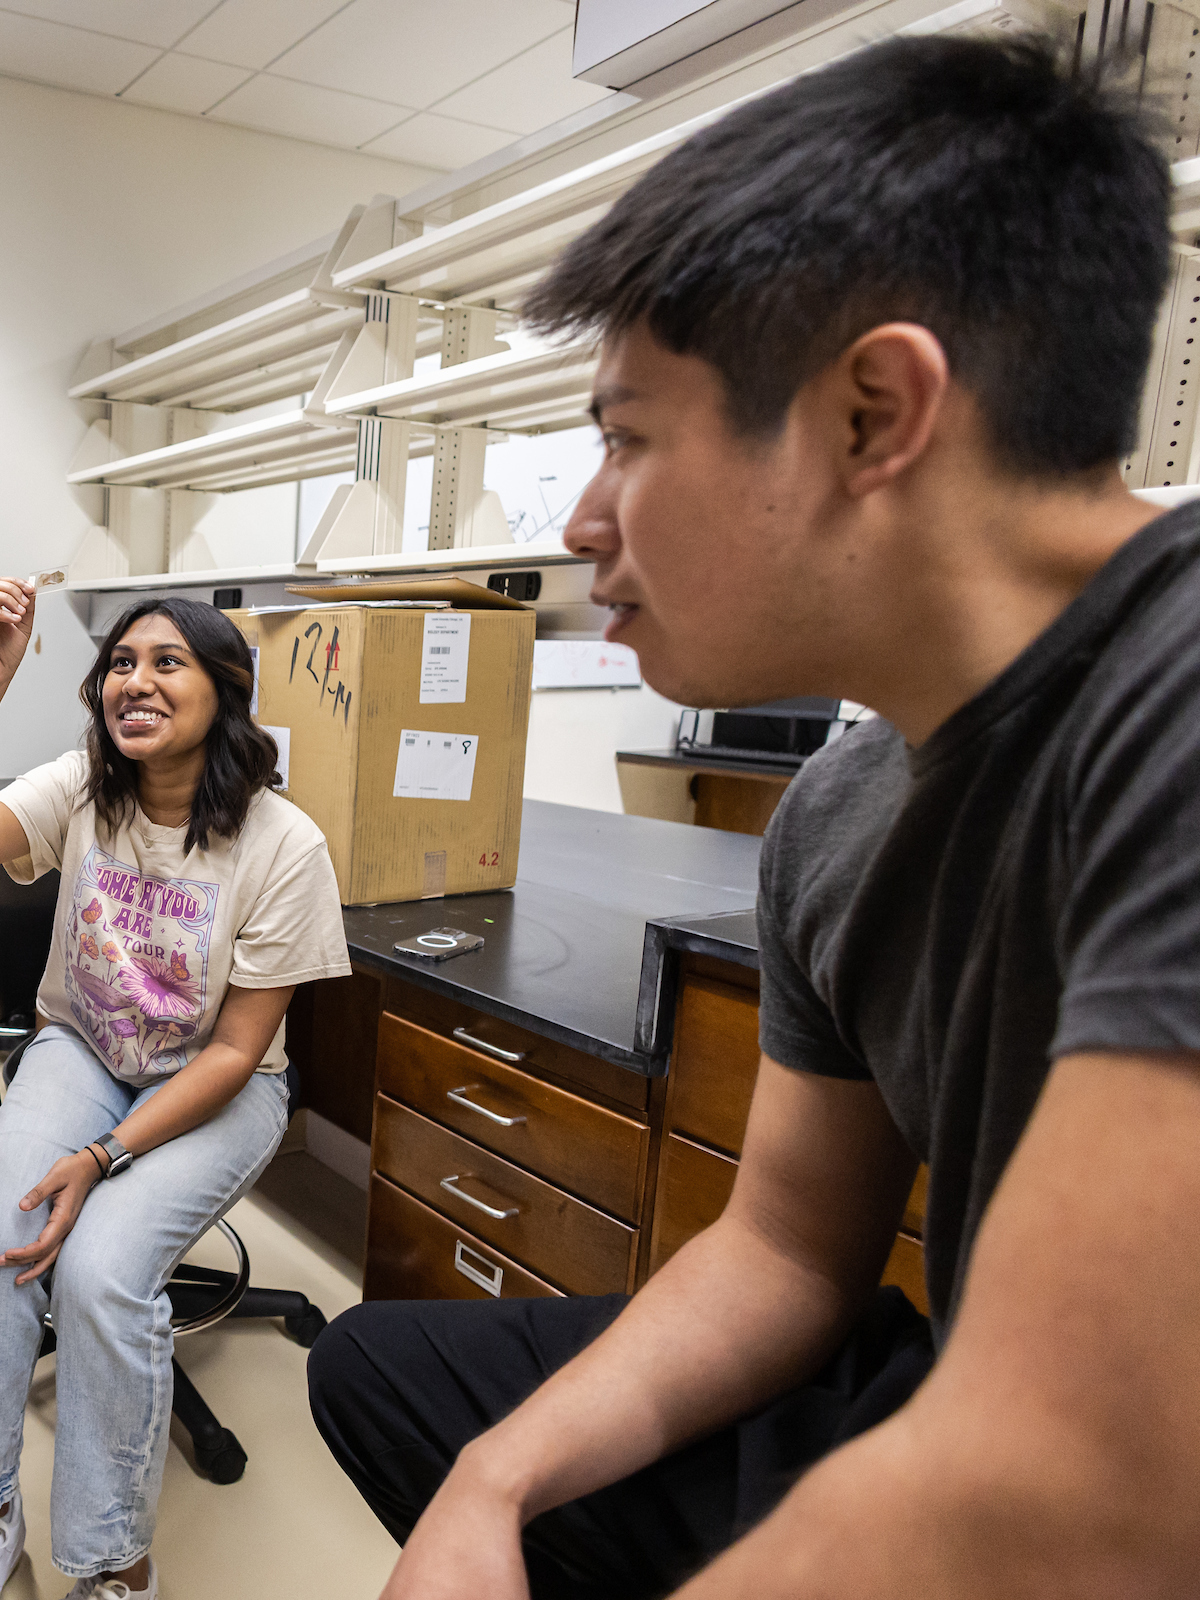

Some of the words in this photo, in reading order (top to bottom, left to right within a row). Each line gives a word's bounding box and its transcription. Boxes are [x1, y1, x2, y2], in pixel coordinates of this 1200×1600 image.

[478, 851, 499, 867] 4.2
[157, 886, 199, 921] YOU
[111, 907, 153, 940] ARE
[122, 935, 165, 959] TOUR
